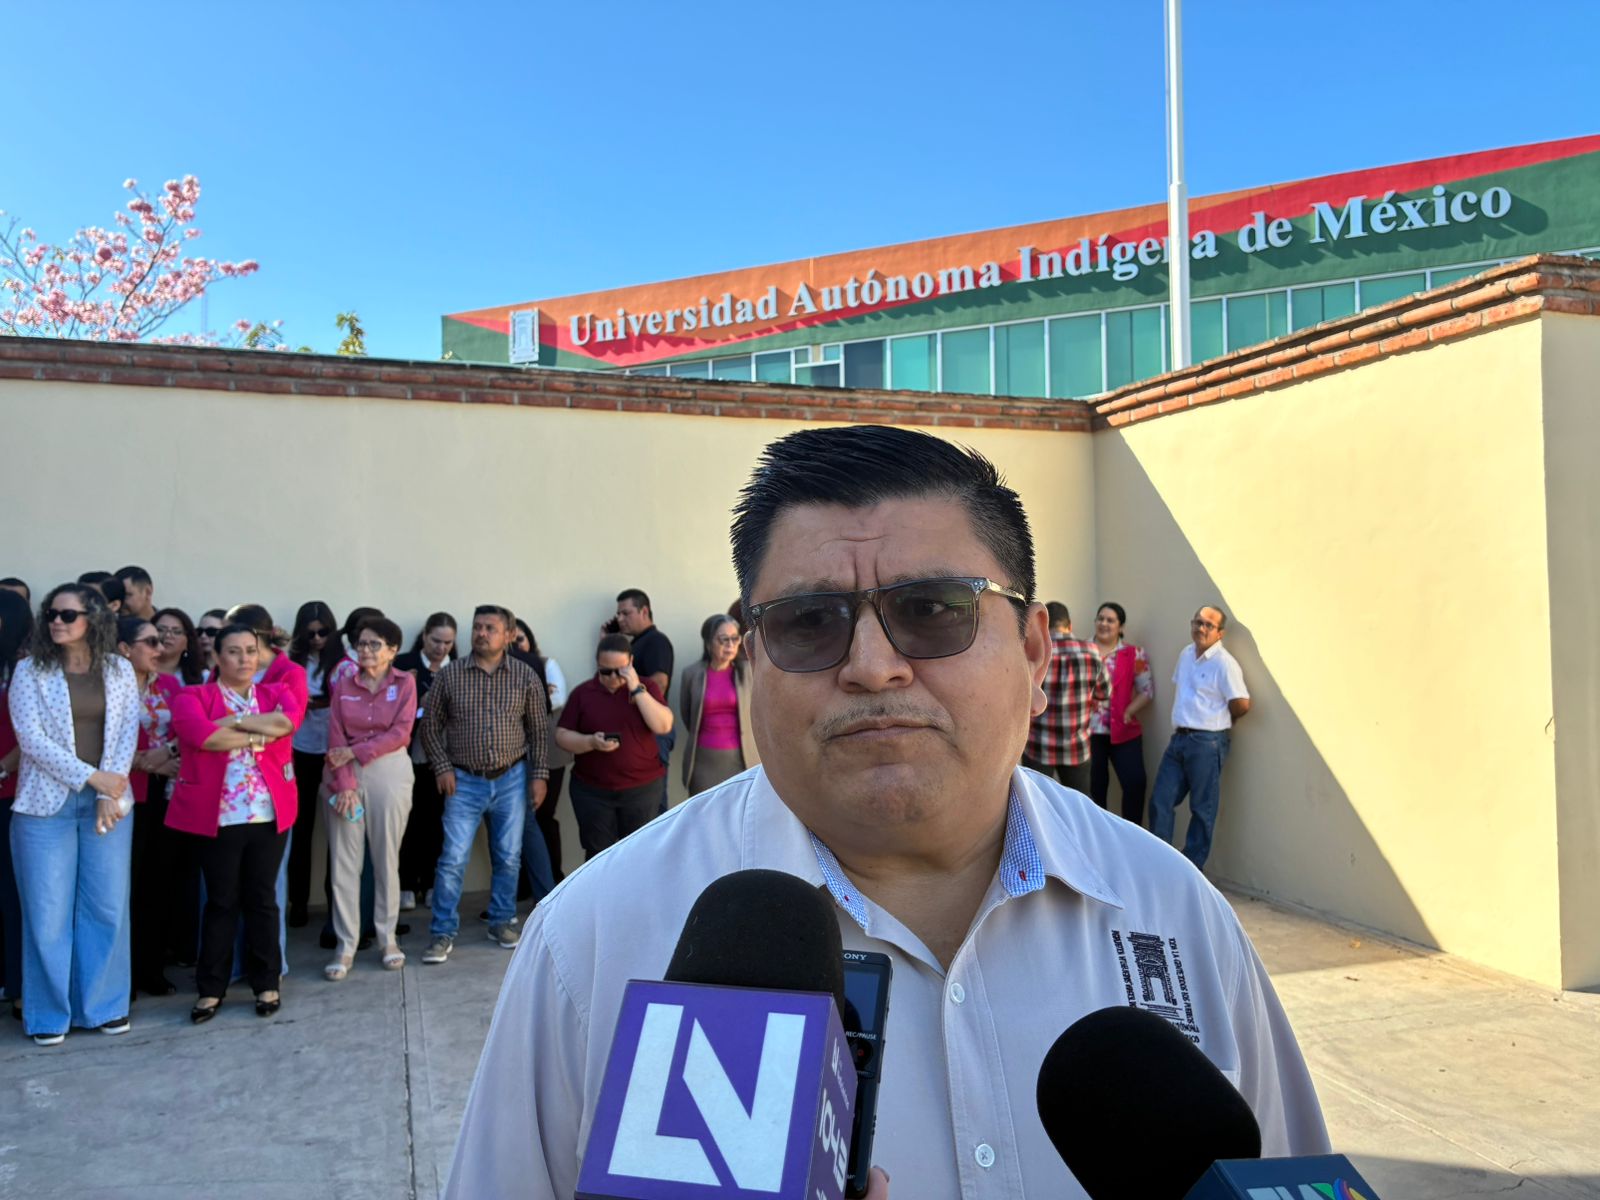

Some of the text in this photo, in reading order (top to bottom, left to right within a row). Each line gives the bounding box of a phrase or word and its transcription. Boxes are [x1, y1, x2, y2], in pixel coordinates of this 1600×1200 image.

[569, 285, 778, 346] Universidad
[788, 260, 1002, 316] Autónoma
[1237, 211, 1293, 254] de
[1310, 184, 1512, 244] México
[843, 953, 867, 961] ONY
